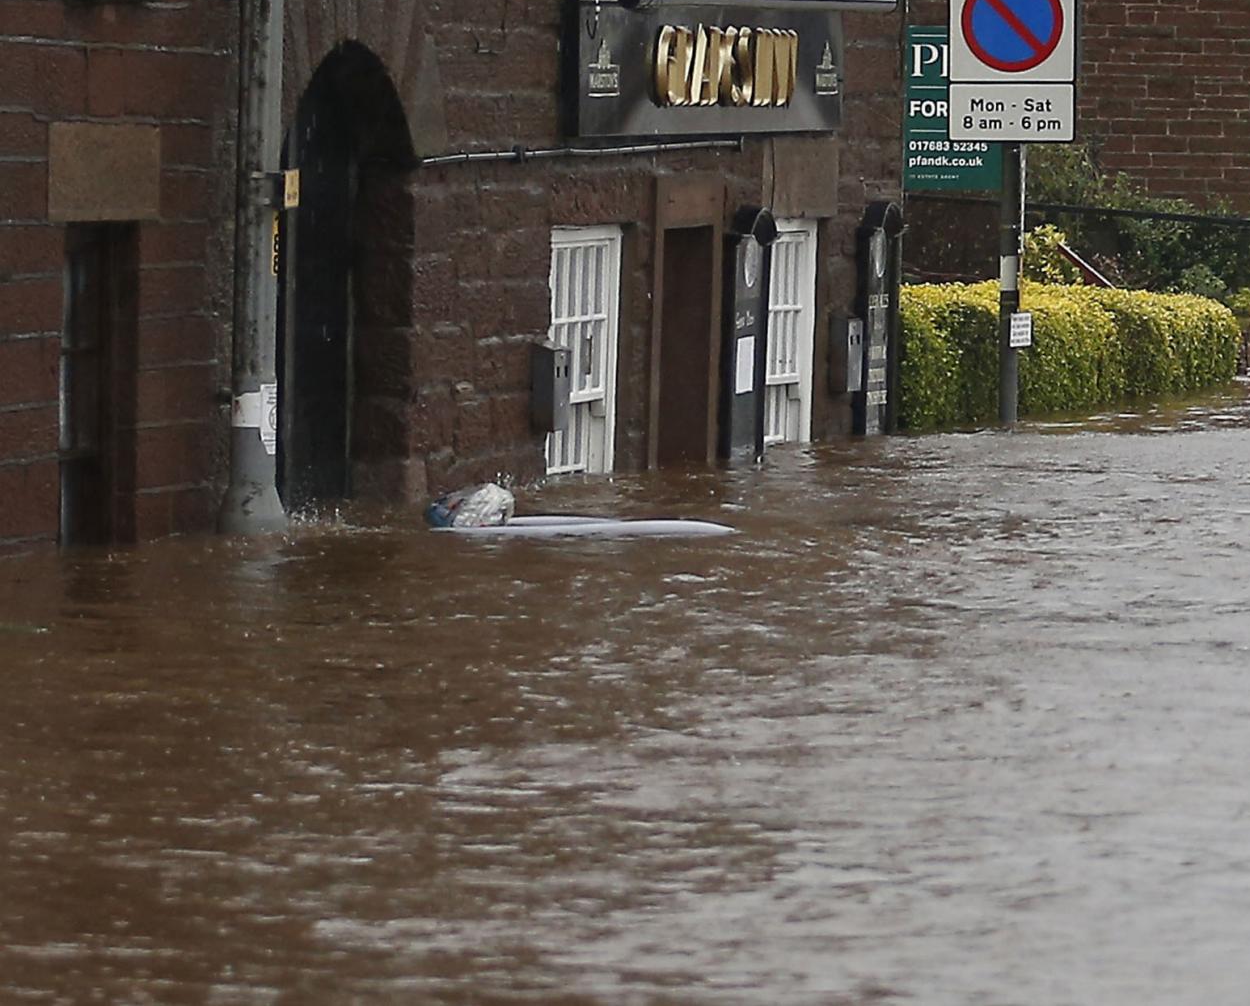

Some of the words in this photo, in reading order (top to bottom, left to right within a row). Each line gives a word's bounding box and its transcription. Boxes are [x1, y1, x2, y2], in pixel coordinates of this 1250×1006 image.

[910, 100, 948, 117] FOR
[970, 98, 1005, 113] Mon
[1023, 98, 1052, 113] Sat
[962, 115, 974, 130] 8
[978, 118, 1003, 130] am
[1021, 115, 1032, 130] 6
[1036, 118, 1061, 132] pm
[908, 141, 951, 152] 017683
[908, 155, 983, 168] pfandk.co.uk
